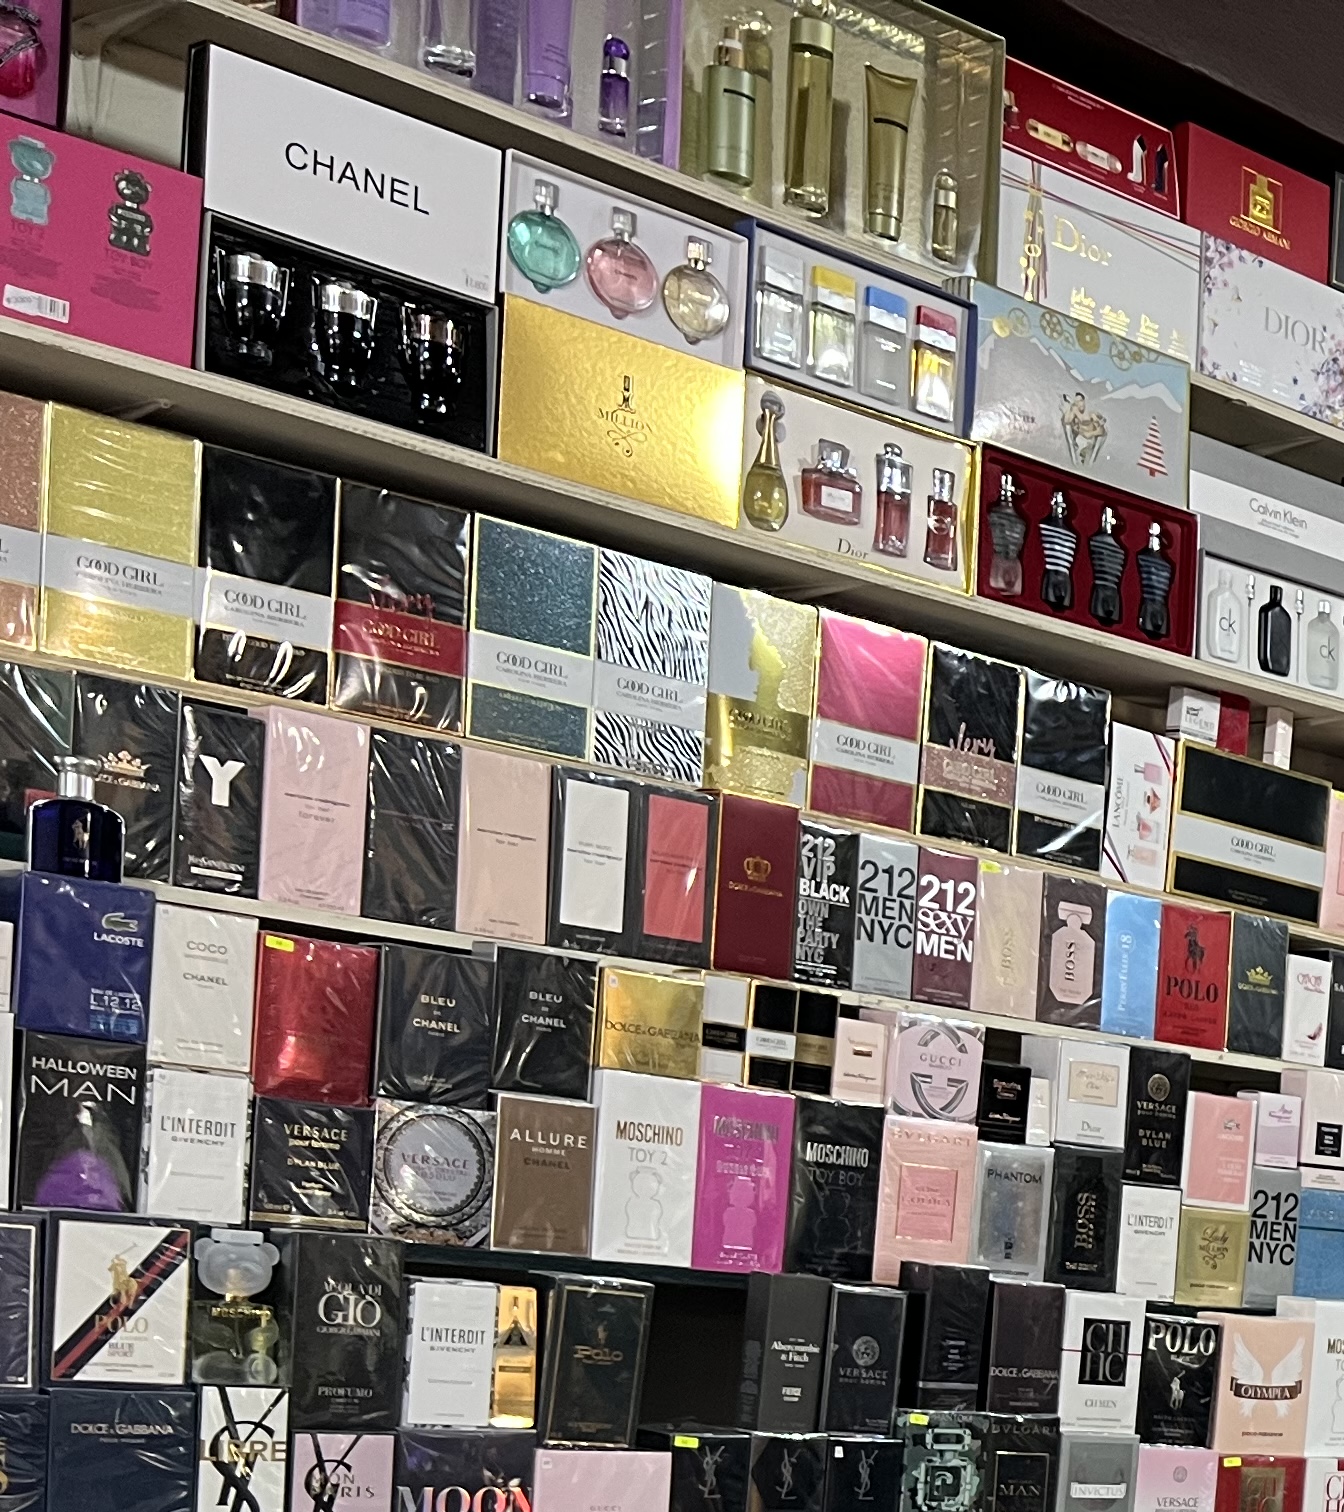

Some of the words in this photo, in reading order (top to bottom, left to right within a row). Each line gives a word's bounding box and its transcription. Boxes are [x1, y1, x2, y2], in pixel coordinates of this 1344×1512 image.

[284, 141, 431, 216] CHANEL
[1052, 215, 1112, 268] Dior
[1263, 305, 1329, 355] DIOR
[598, 409, 654, 435] MILLION
[1248, 496, 1277, 524] Calvin
[1275, 507, 1308, 531] Klein
[837, 537, 870, 562] Dior
[76, 554, 120, 580] GOOD
[121, 565, 165, 588] GIRL
[224, 588, 265, 611] GOOD
[266, 598, 307, 621] GIRL
[1218, 614, 1237, 636] ck
[1319, 641, 1336, 664] ck
[496, 650, 532, 671] GOOD
[533, 660, 569, 680] GIRL
[616, 677, 649, 696] GOOD
[650, 684, 681, 704] GIRL
[836, 732, 864, 751] GOOD
[865, 740, 896, 760] GIRL
[199, 755, 246, 808] Y
[1035, 781, 1059, 798] GOOD
[1060, 788, 1088, 805] GIRL
[802, 833, 836, 862] 212
[1231, 835, 1252, 852] GOOD
[1253, 841, 1277, 858] GIRL
[802, 860, 836, 882] VIP
[859, 860, 915, 899] 212
[800, 879, 850, 904] BLACK
[920, 874, 976, 915] 212
[799, 901, 829, 919] OWN
[859, 895, 914, 924] MEN
[799, 915, 824, 933] THE
[857, 917, 913, 950] NYC
[94, 931, 145, 948] LACOSTE
[187, 940, 228, 955] COCO
[796, 929, 839, 950] PARTY
[917, 934, 974, 963] MEN
[796, 945, 824, 963] NYC
[1063, 940, 1077, 984] BOSS
[183, 972, 228, 987] CHANEL
[1165, 975, 1219, 1004] POLO
[420, 994, 456, 1008] BLEU
[529, 989, 564, 1004] BLEU
[413, 1018, 460, 1034] CHANEL
[521, 1013, 567, 1030] CHANEL
[32, 1055, 138, 1082] HALLOWEEN
[919, 1052, 963, 1067] GUCCI
[31, 1076, 137, 1105] MAN
[1136, 1100, 1176, 1114] VERSACE
[160, 1115, 237, 1140] L'INTERDIT
[284, 1122, 348, 1143] VERSACE
[616, 1119, 684, 1147] MOSCHINO
[1081, 1120, 1102, 1133] Dior
[1139, 1129, 1171, 1140] DYLAN
[171, 1137, 226, 1148] GIVENCHY
[510, 1127, 589, 1150] ALLURE
[1142, 1136, 1168, 1148] BLUE
[402, 1151, 470, 1171] VERSACE
[523, 1157, 571, 1171] CHANEL
[628, 1147, 656, 1164] TOY
[660, 1151, 669, 1166] 2
[806, 1141, 869, 1169] MOSCHINO
[808, 1167, 837, 1185] TOY
[838, 1169, 866, 1188] BOY
[987, 1168, 1043, 1184] PHANTOM
[1253, 1190, 1299, 1221] 212
[1127, 1211, 1175, 1228] L'INTERDIT
[1250, 1219, 1297, 1243] MEN
[1248, 1241, 1295, 1266] NYC
[95, 1314, 149, 1334] POLO
[211, 1306, 273, 1321] MOSCHINO
[420, 1325, 486, 1346] L'INTERDIT
[1085, 1321, 1131, 1354] CH
[1147, 1321, 1216, 1356] POLO
[572, 1345, 624, 1362] Polo
[770, 1341, 820, 1355] Abercrombie
[839, 1368, 889, 1381] VERSACE
[1082, 1352, 1126, 1384] HC
[317, 1386, 373, 1400] PROFUMO
[1000, 1482, 1041, 1498] MAN
[1072, 1482, 1127, 1498] INVICTUS
[1156, 1496, 1199, 1509] VERSACE
